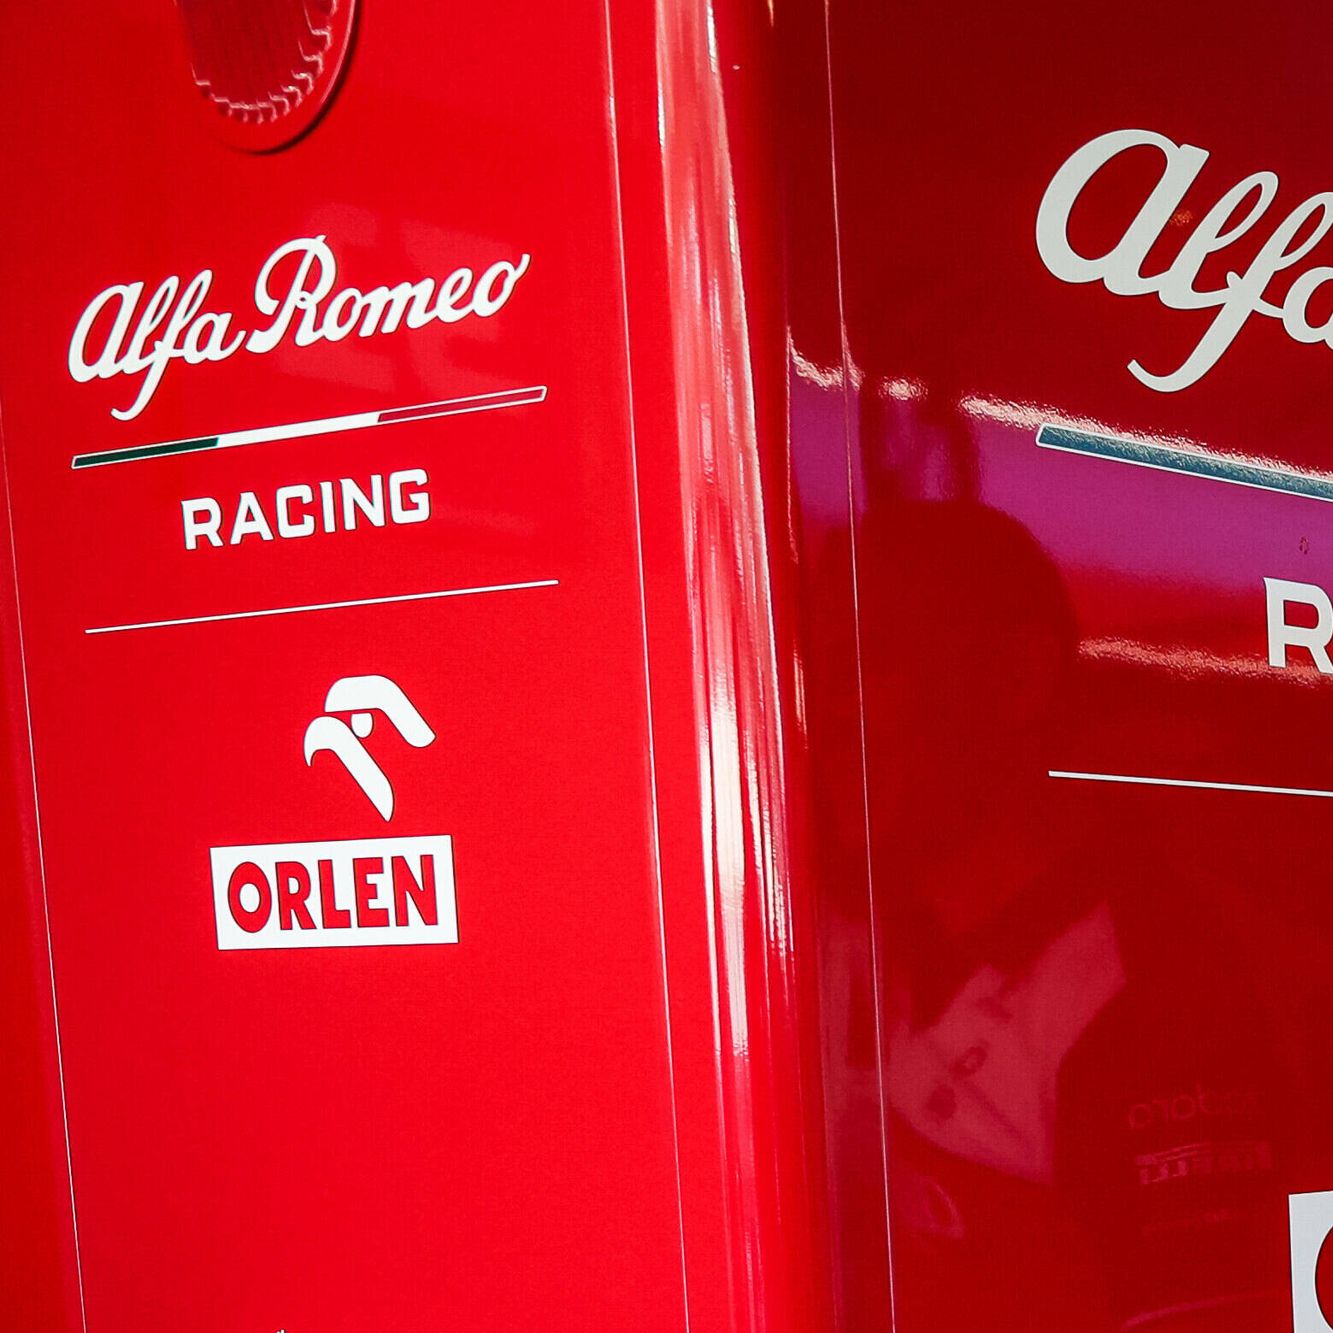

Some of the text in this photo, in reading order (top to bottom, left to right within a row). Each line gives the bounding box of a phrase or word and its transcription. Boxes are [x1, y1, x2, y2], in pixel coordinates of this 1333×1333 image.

[68, 235, 531, 421] Alfa Romeo
[181, 468, 432, 551] RACING
[227, 854, 439, 933] ORLEN
